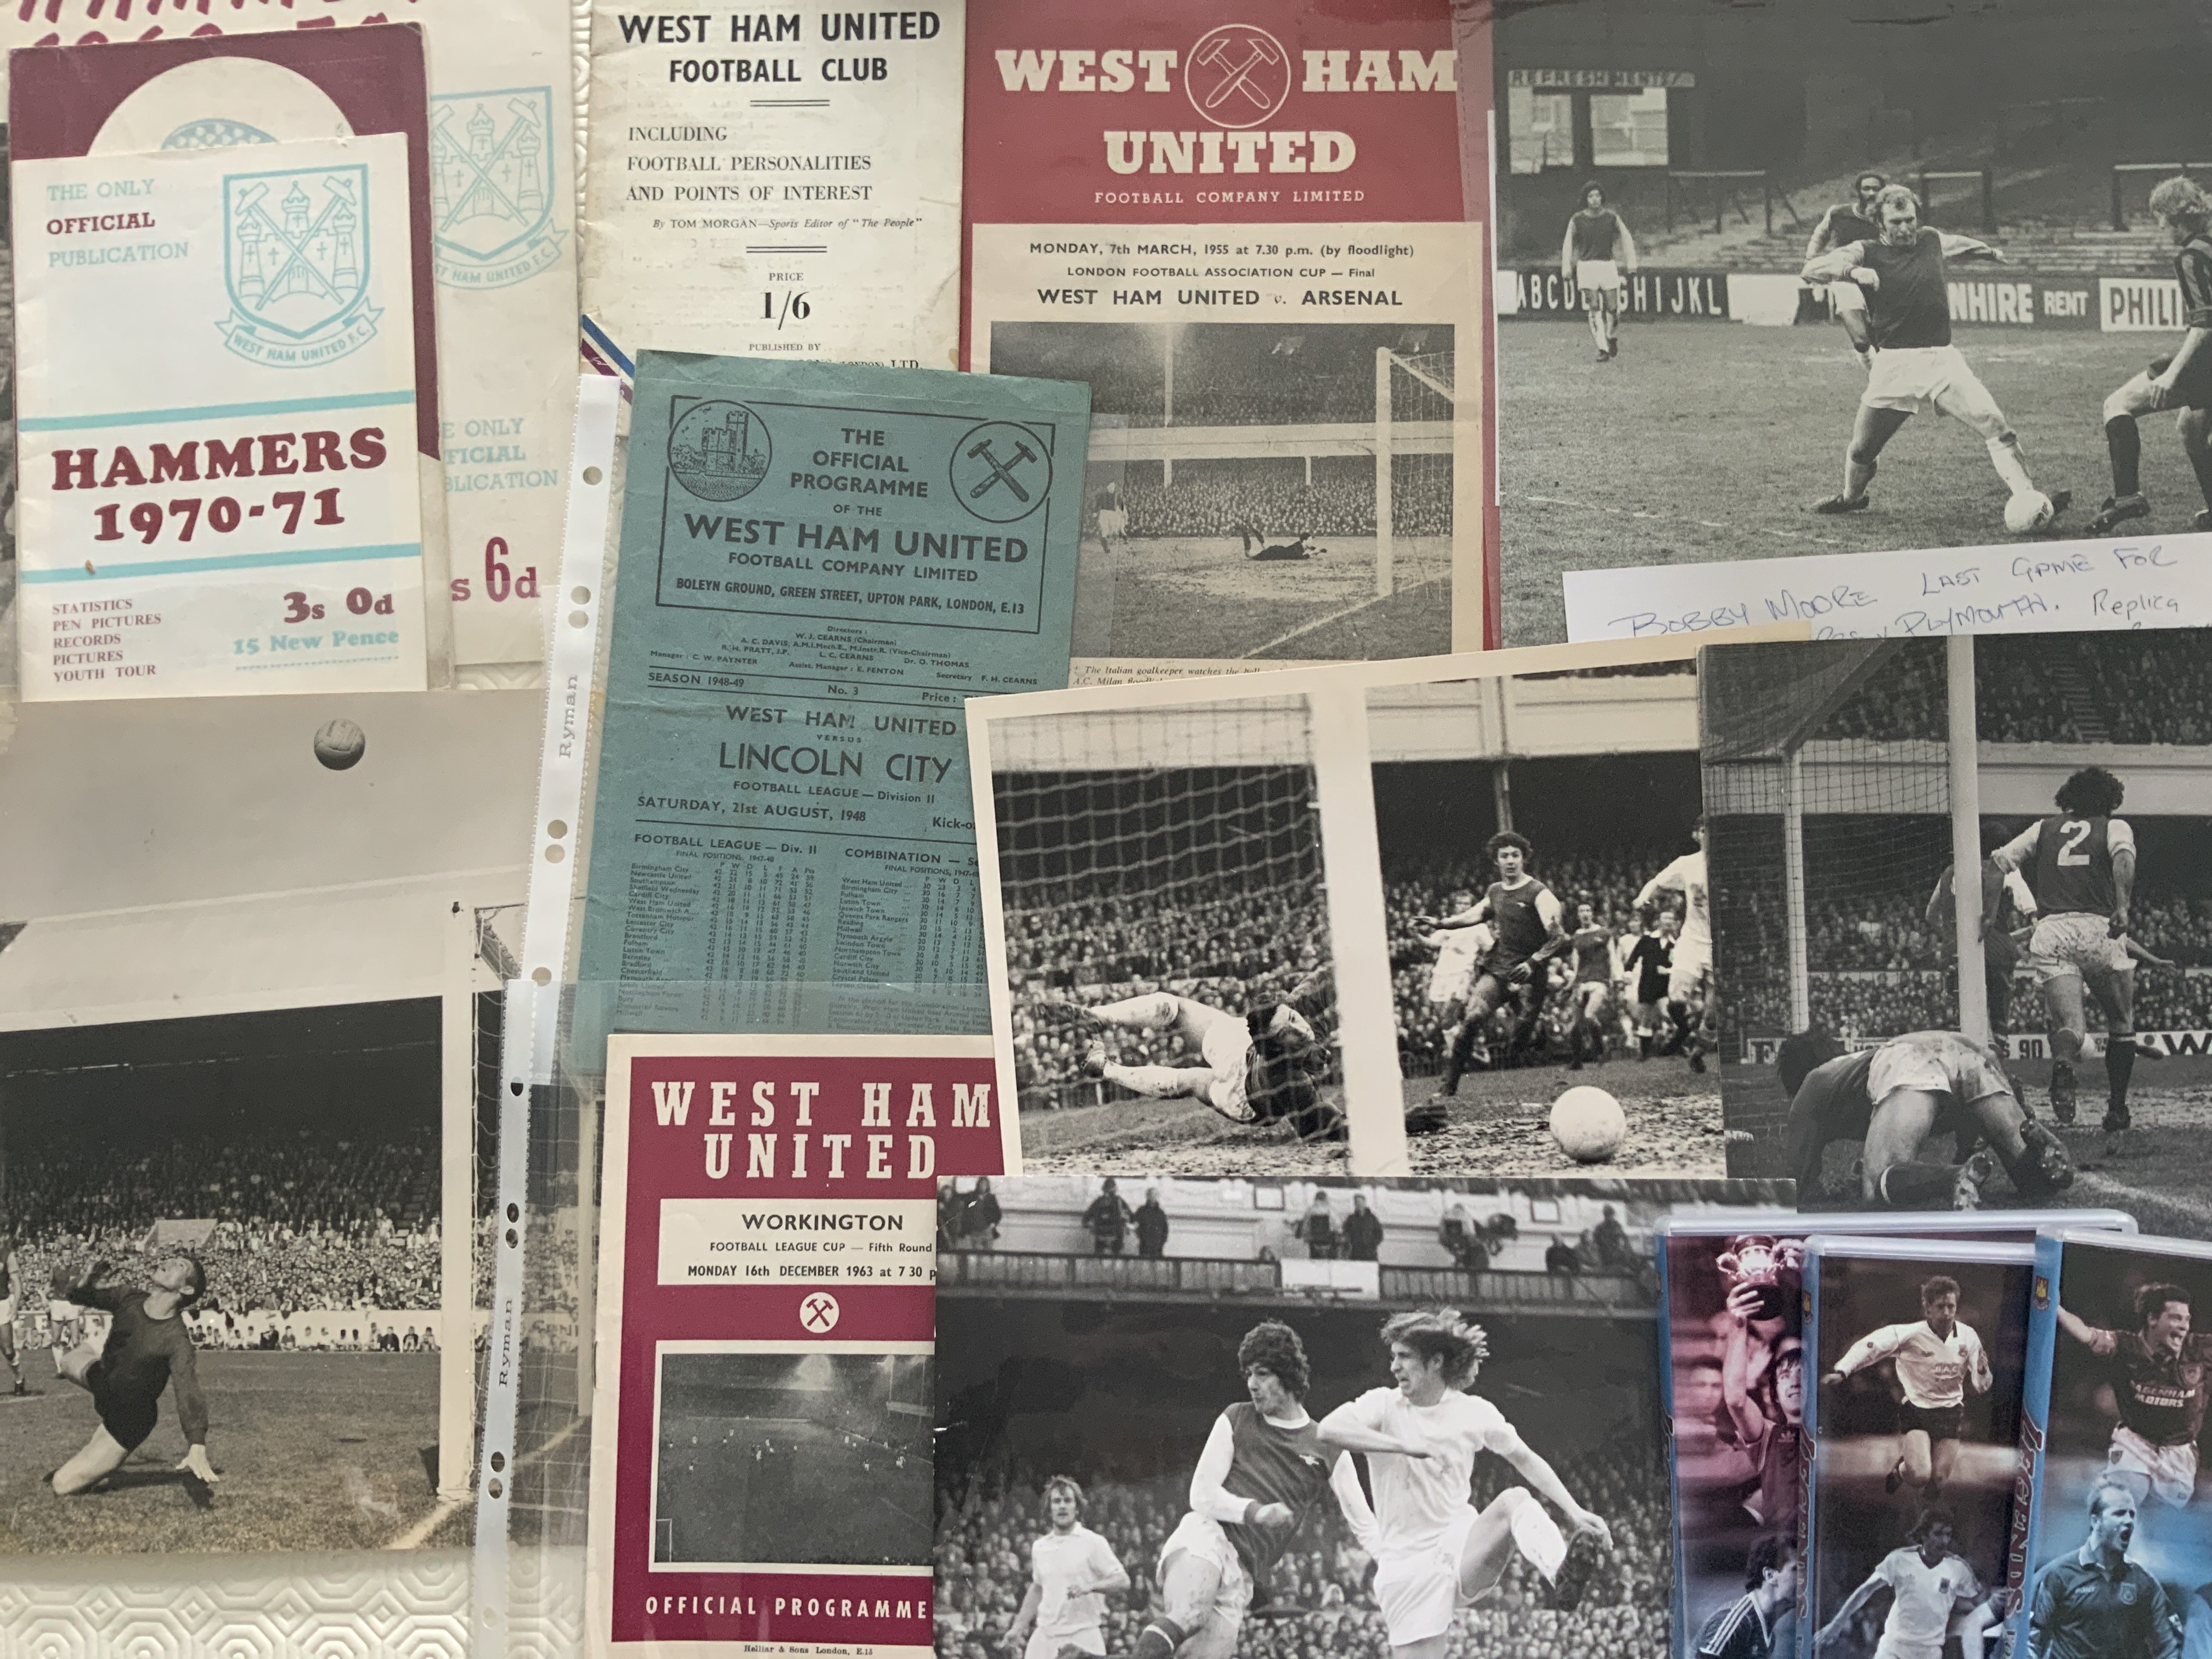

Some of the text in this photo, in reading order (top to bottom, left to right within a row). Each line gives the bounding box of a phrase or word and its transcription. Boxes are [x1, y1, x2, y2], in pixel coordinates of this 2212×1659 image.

[618, 11, 940, 43] WEST HAM UNITED
[670, 57, 887, 83] FOOTBALL CLUB
[995, 49, 1178, 93] WEST
[1302, 50, 1458, 92] HAM
[630, 126, 726, 141] INCLUDING
[628, 156, 871, 171] FOOTBALL PERSONALITIES
[1104, 131, 1356, 174] UNITED
[47, 178, 154, 201] THE ONLY
[627, 185, 872, 201] AND POINTS OF INTEREST
[1095, 190, 1364, 204] FOOTBALL COMPANY LIMITED
[47, 212, 155, 235] OFFICIAL
[653, 219, 665, 230] By
[670, 219, 696, 228] TOM
[804, 219, 833, 228] Editor
[838, 219, 848, 229] of
[49, 242, 188, 267] PUBLICATION
[1030, 243, 1413, 258] MONDAY, 7th MARCH, 1955 at 7.30 p.m. (by floodlight)
[769, 273, 803, 281] PRICE
[1068, 267, 1374, 277] LONDON FOOTBALL ASSOCIATION CUP Final
[1037, 289, 1098, 304] WEST
[1114, 290, 1161, 305] HAM
[1178, 289, 1260, 306] UNITED
[1302, 290, 1402, 306] ARSENAL
[2044, 291, 2087, 315] RENT
[759, 291, 811, 330] 1/6
[233, 336, 262, 356] WEST
[267, 348, 296, 362] HAM
[301, 340, 347, 361] UNITED
[842, 428, 884, 446] THE
[51, 427, 387, 491] HAMMERS
[813, 450, 909, 473] OFFICIAL
[791, 472, 928, 498] PROGRAMME
[94, 487, 345, 544] 1970-71
[833, 504, 882, 516] OF THE
[684, 514, 1028, 563] WEST HAM UNITED
[729, 552, 978, 582] FOOTBALL COMPANY LIMITED
[1922, 568, 1982, 595] LAST
[54, 600, 132, 614] STATISTICS
[284, 591, 325, 624] 3s
[676, 578, 1024, 614] BOLEYN GROUND, GREEN STREET, UPTON PARK, LONDON, E.13
[54, 614, 161, 631] PEN PICTURES
[54, 634, 121, 648] RECORDS
[235, 630, 398, 656] 15 New Pence
[54, 651, 122, 665] PICTURES
[54, 665, 155, 682] YOUTH TOUR
[648, 673, 744, 687] SEASON 1948-49
[1085, 666, 1101, 674] The
[1137, 666, 1183, 676] goalkeeper
[828, 685, 859, 696] No. 3
[559, 675, 578, 758] Ryman
[726, 706, 956, 736] WEST HAM UNITED
[817, 734, 861, 743] VERSUS
[720, 742, 952, 783] LINCOLN CITY
[733, 781, 800, 794] FOOTBALL
[809, 786, 859, 798] LEAGUE
[878, 791, 921, 803] Division
[638, 796, 866, 822] SATURDAY, 21st AUGUST, 1948
[2057, 820, 2090, 866] 2
[652, 1081, 991, 1127] WEST HAM
[704, 1133, 935, 1179] UNITED
[742, 1214, 902, 1231] WORKINGTON
[710, 1242, 932, 1252] FOOTBALL LEAGUE CUP Fifth Round
[688, 1265, 891, 1277] MONDAY 16th DECEMBER 1963 at
[499, 1300, 511, 1387] Ryman
[646, 1596, 926, 1619] OFFICIAL PROGRAMME
[816, 1646, 850, 1655] London,
